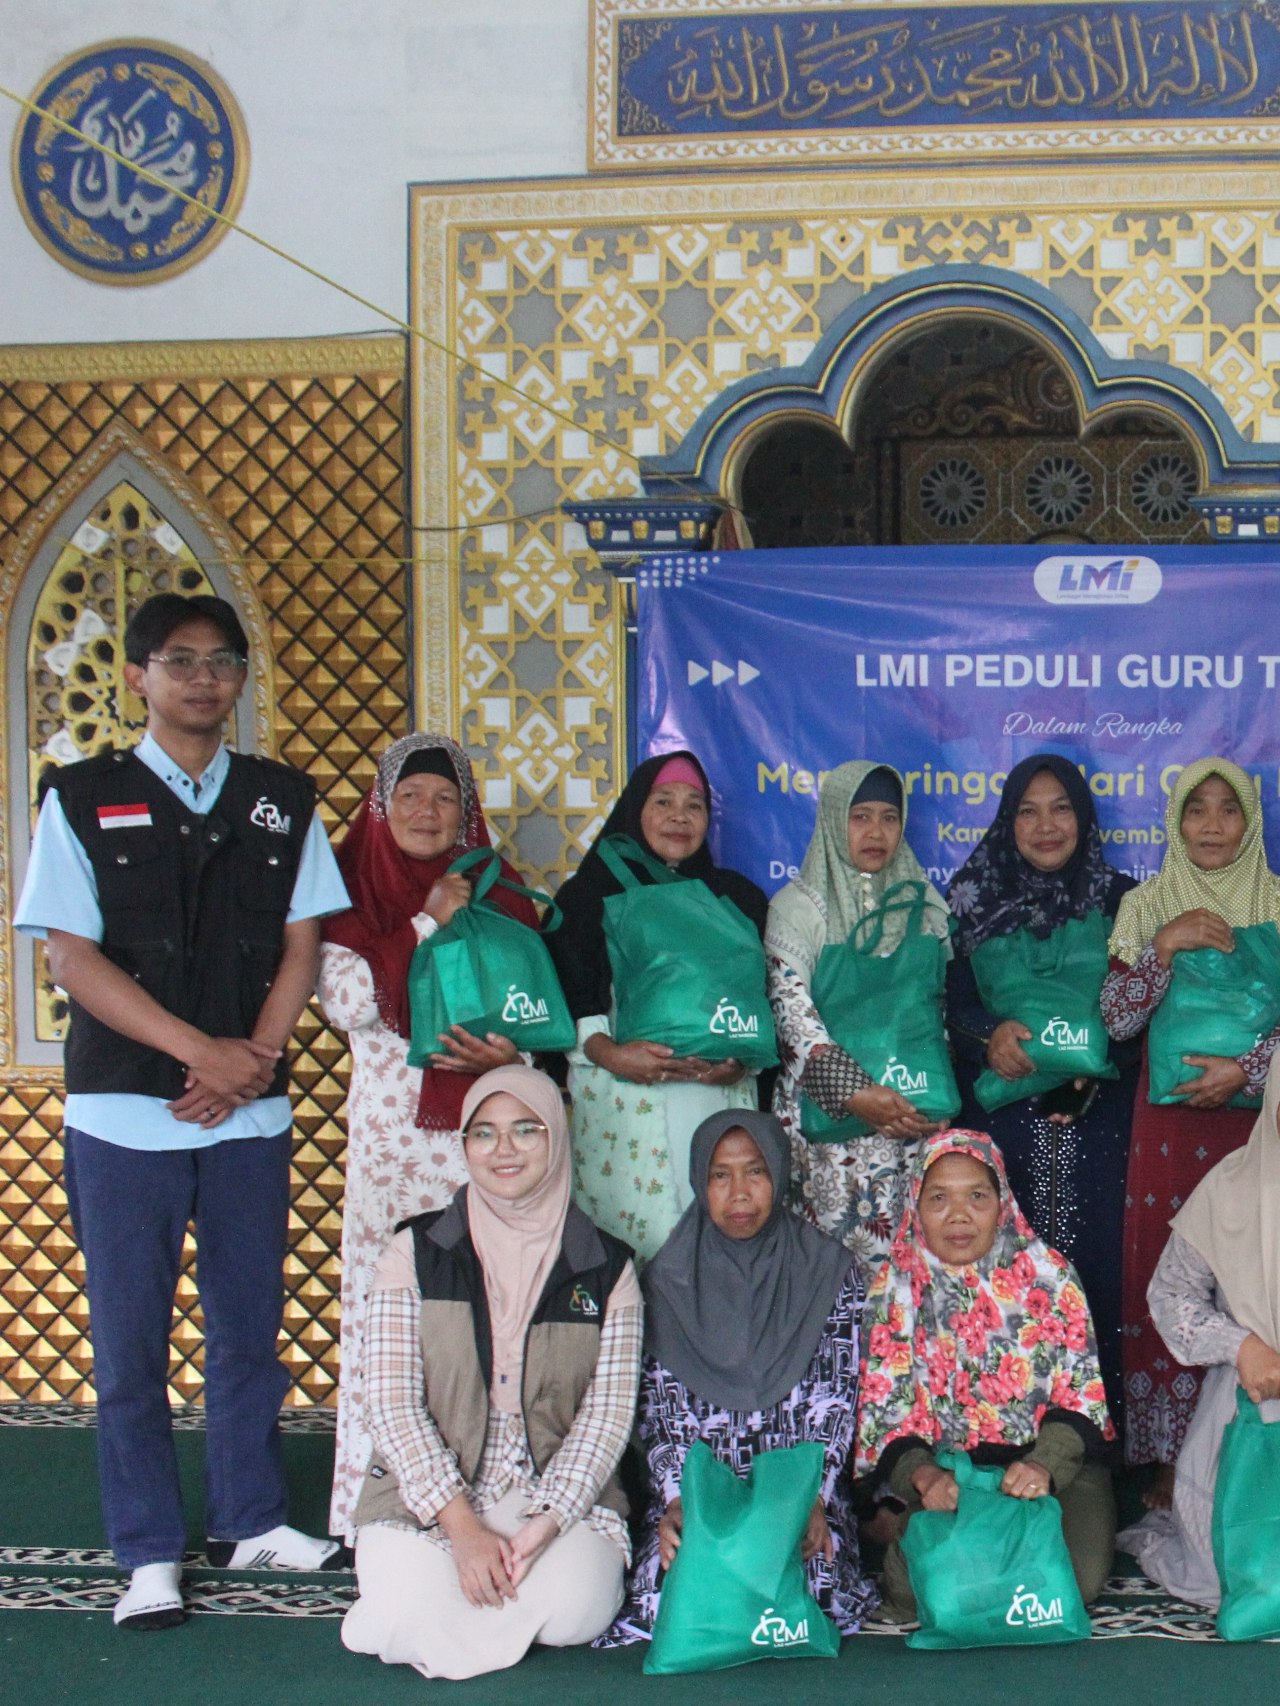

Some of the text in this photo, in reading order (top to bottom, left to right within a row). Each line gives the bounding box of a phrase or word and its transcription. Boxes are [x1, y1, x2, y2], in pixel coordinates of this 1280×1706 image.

[856, 654, 928, 687] LMI
[945, 654, 1101, 687] PEDULI
[1117, 654, 1243, 688] GURU
[1003, 711, 1183, 741] Dalam Rangka
[1078, 764, 1145, 796] ari
[520, 998, 549, 1019] LMI
[728, 1015, 758, 1032] LMI
[1057, 1028, 1089, 1045] LMI
[897, 1071, 928, 1090] LMI
[1027, 1597, 1063, 1622] LMI
[773, 1618, 808, 1643] LMI
